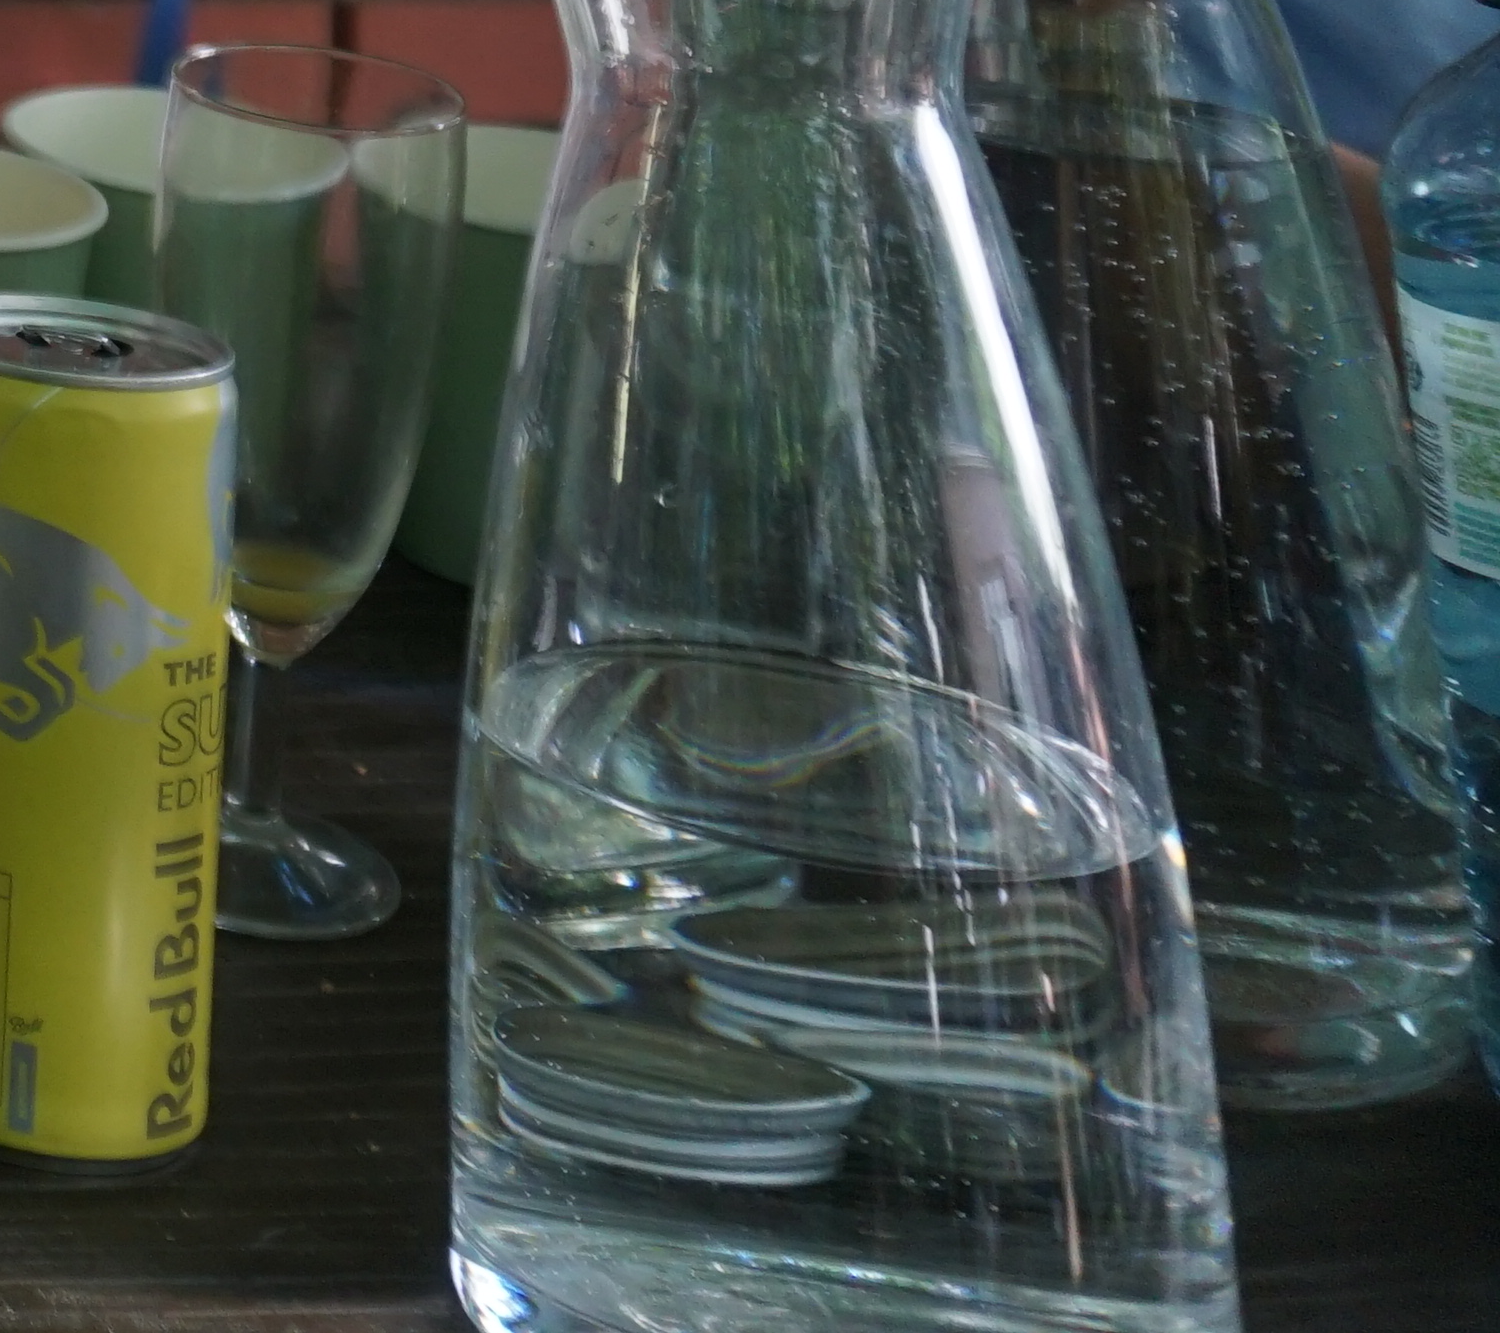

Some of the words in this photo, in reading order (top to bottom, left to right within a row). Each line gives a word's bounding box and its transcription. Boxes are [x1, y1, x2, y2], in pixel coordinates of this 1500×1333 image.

[158, 687, 227, 767] SU
[163, 652, 217, 687] THE
[153, 831, 204, 981] Bull
[146, 988, 198, 1140] Red
